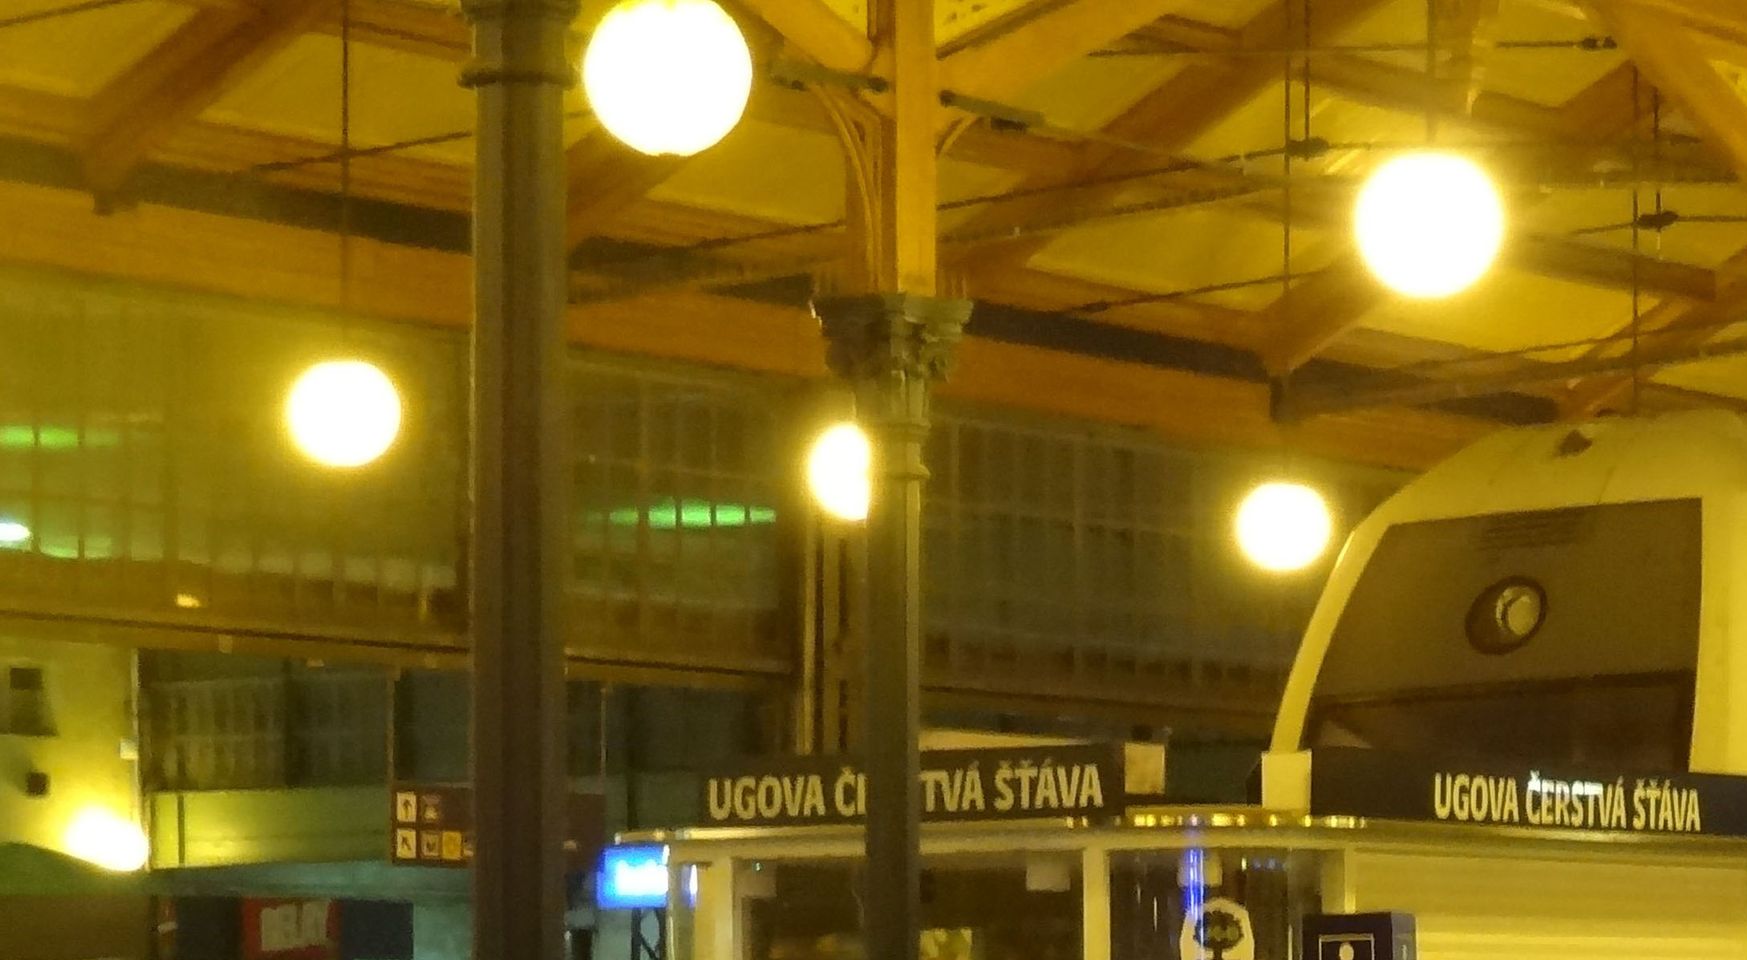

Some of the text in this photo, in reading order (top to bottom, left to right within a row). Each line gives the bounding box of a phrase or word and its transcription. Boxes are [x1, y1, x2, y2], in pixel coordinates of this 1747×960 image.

[708, 774, 826, 820] UGOVA
[994, 756, 1104, 811] ŠŤÁVA
[1434, 769, 1701, 832] UGOVA ČERSTVÁ ŠŤÁVA
